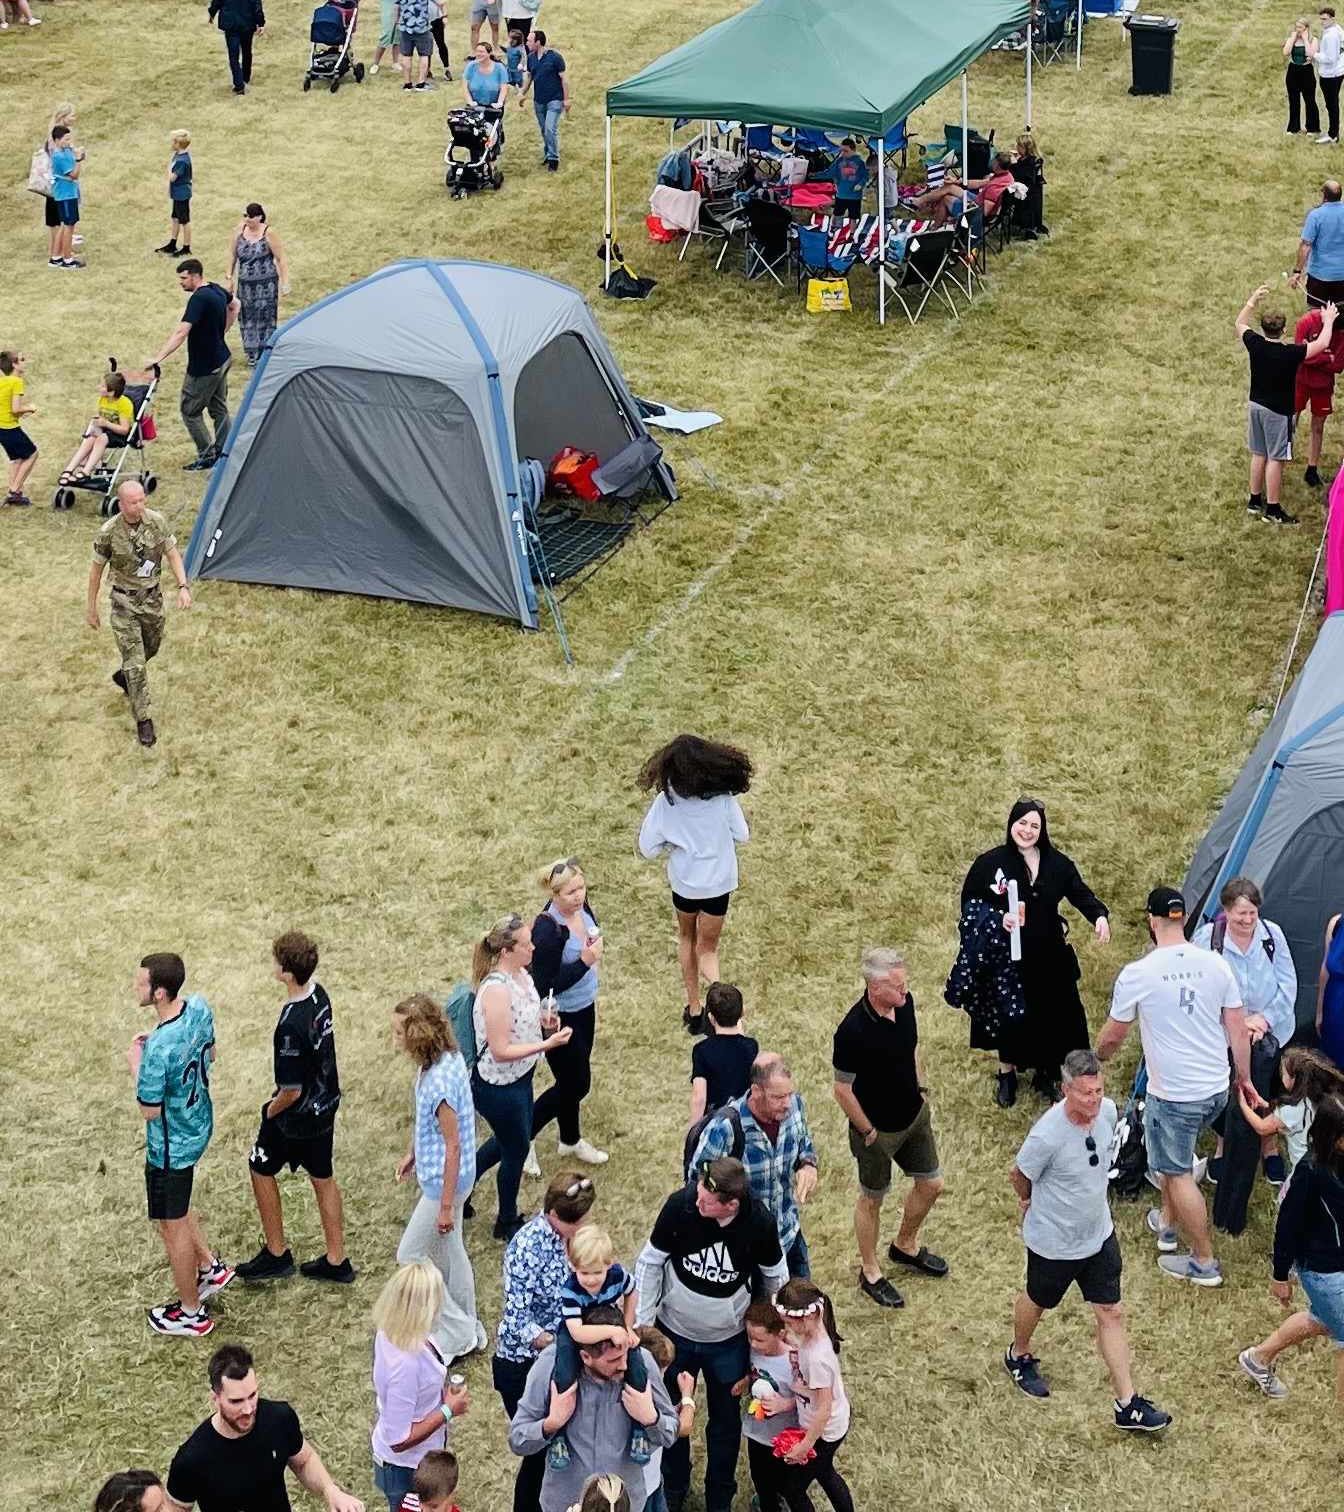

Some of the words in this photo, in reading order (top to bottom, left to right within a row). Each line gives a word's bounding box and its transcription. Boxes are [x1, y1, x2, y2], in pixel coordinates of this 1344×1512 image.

[1162, 970, 1203, 982] NORRIS
[1179, 987, 1195, 1015] 4
[682, 1255, 740, 1284] adidas
